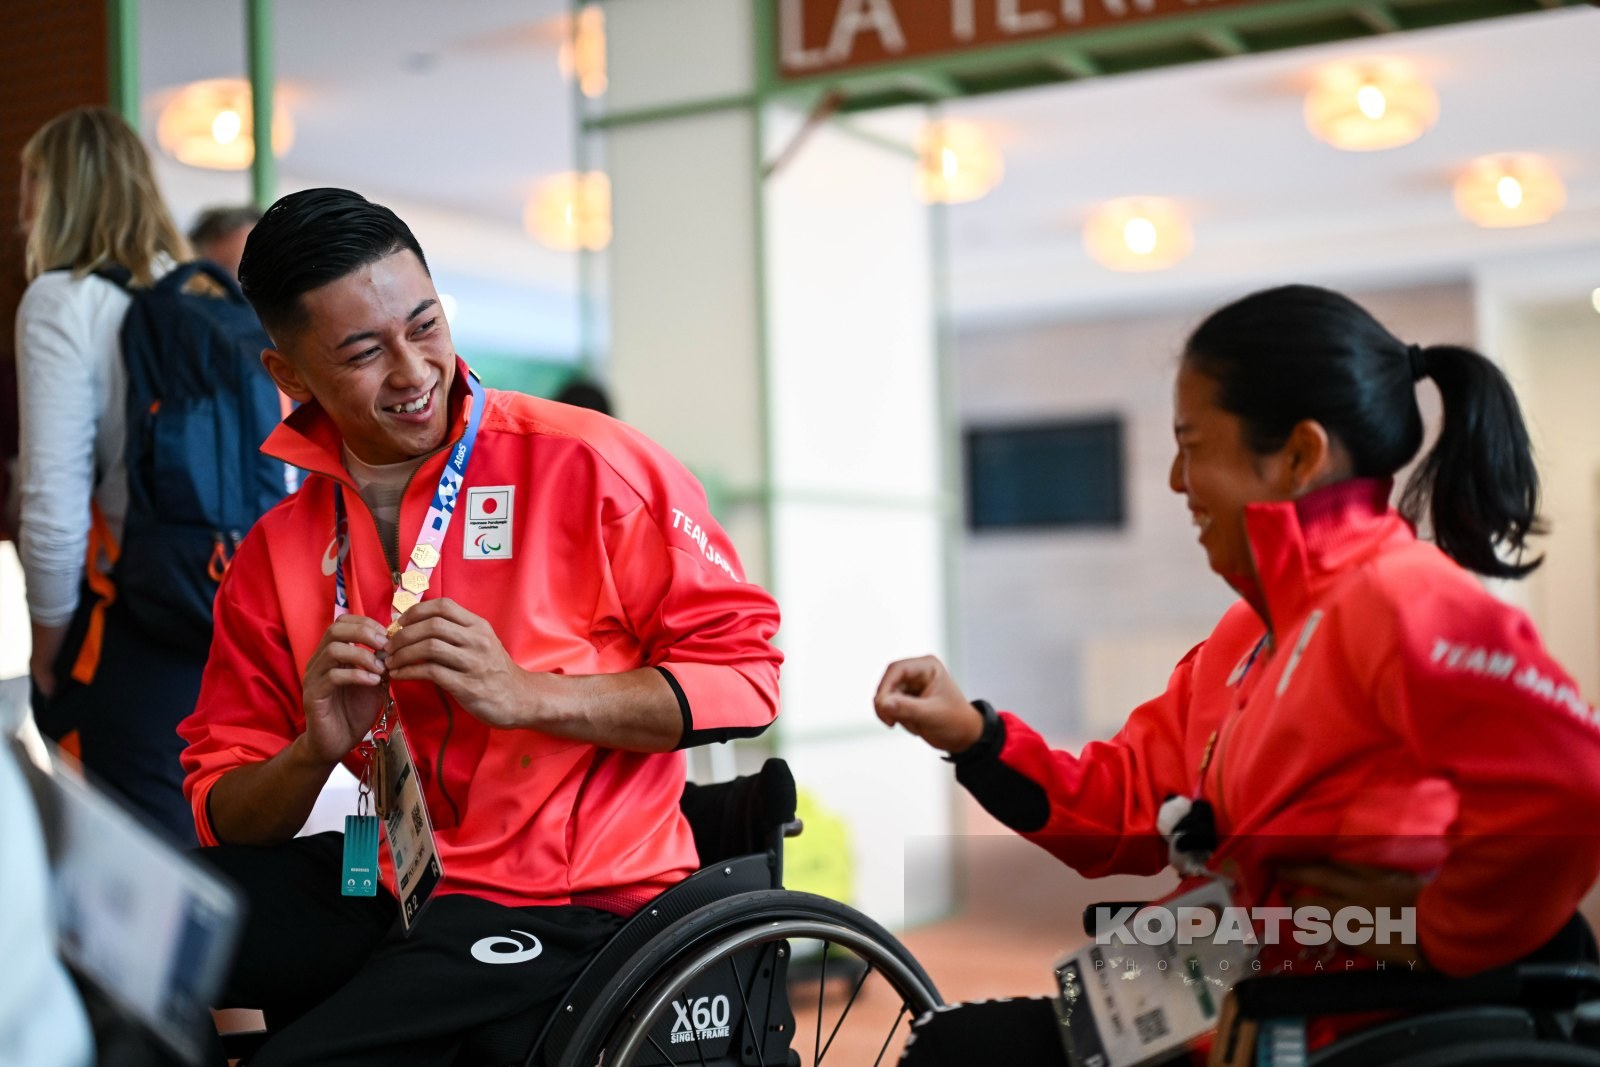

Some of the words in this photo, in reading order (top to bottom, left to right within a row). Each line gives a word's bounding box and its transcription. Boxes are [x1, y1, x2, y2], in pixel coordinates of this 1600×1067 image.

[672, 508, 708, 555] TEAM
[672, 994, 730, 1032] X60
[702, 1029, 729, 1039] FRAME
